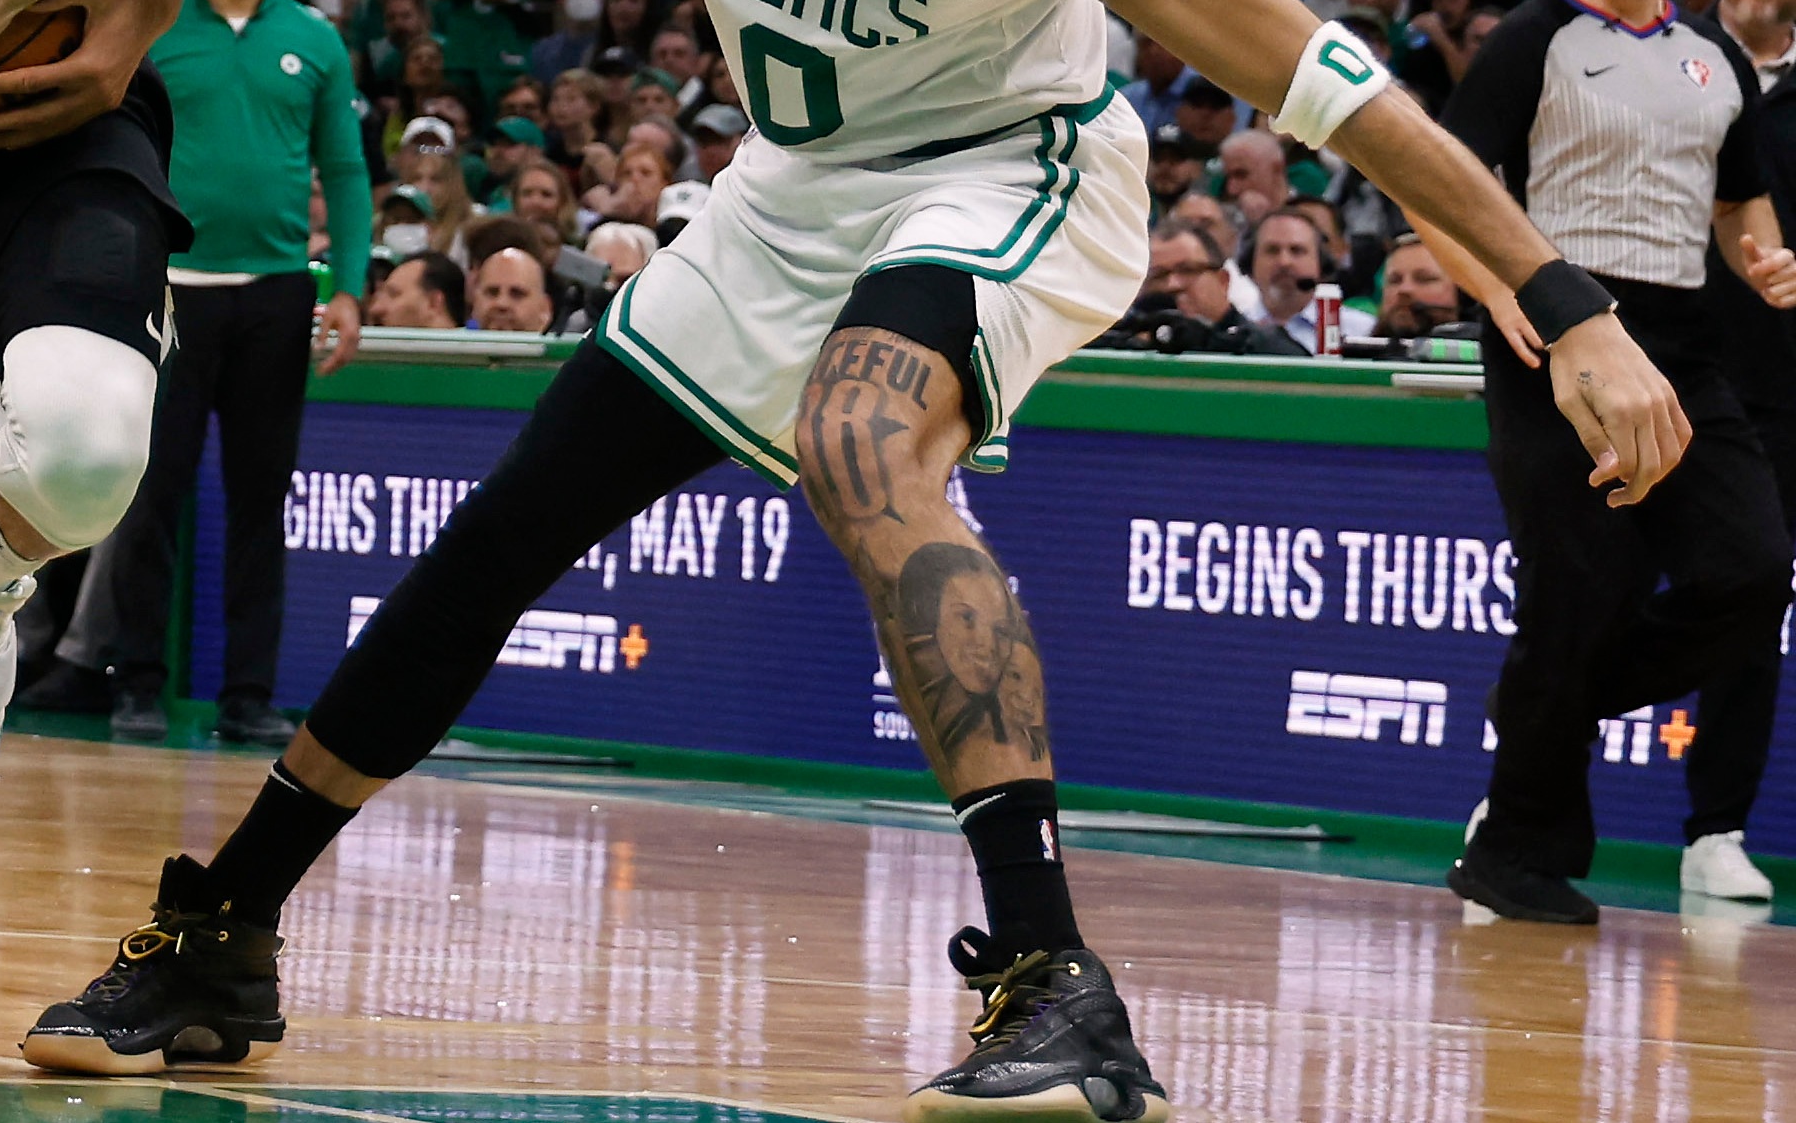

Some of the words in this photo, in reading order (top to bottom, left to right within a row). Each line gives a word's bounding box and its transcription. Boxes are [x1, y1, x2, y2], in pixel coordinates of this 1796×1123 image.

[739, 23, 845, 146] 0
[629, 493, 729, 578] MAY
[736, 496, 790, 583] 19
[1127, 518, 1325, 621] BEGINS
[1286, 669, 1448, 748] ESPN
